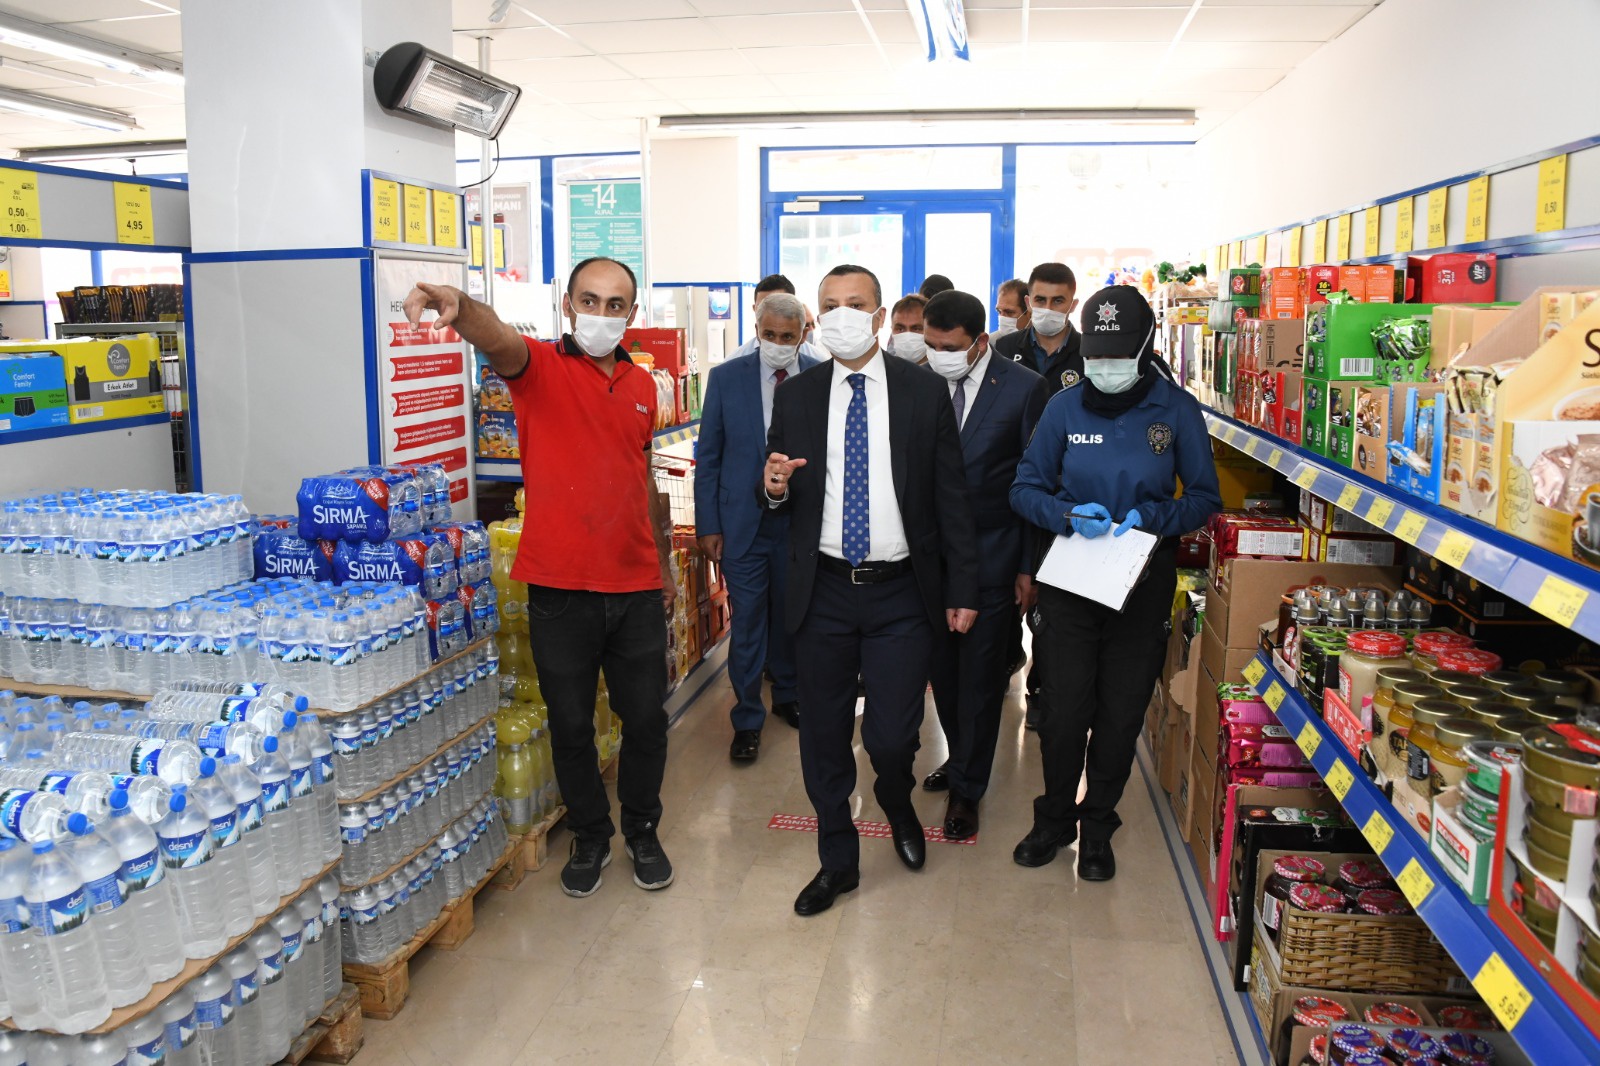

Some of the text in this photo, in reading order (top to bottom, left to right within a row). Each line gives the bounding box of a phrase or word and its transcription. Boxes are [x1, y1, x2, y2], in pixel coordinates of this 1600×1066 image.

[592, 184, 617, 209] 14
[8, 207, 25, 218] 0,50
[9, 223, 26, 233] 1,00
[126, 220, 143, 231] 4,95
[379, 217, 391, 227] 4,45
[410, 221, 420, 231] 4,45
[13, 373, 36, 382] Comfort
[14, 380, 32, 389] Family
[313, 504, 371, 525] SIRMA
[265, 554, 320, 575] SIRMA
[348, 560, 407, 581] SIRMA
[168, 839, 194, 852] desni
[128, 856, 154, 873] desni
[1498, 995, 1520, 1022] 5,95
